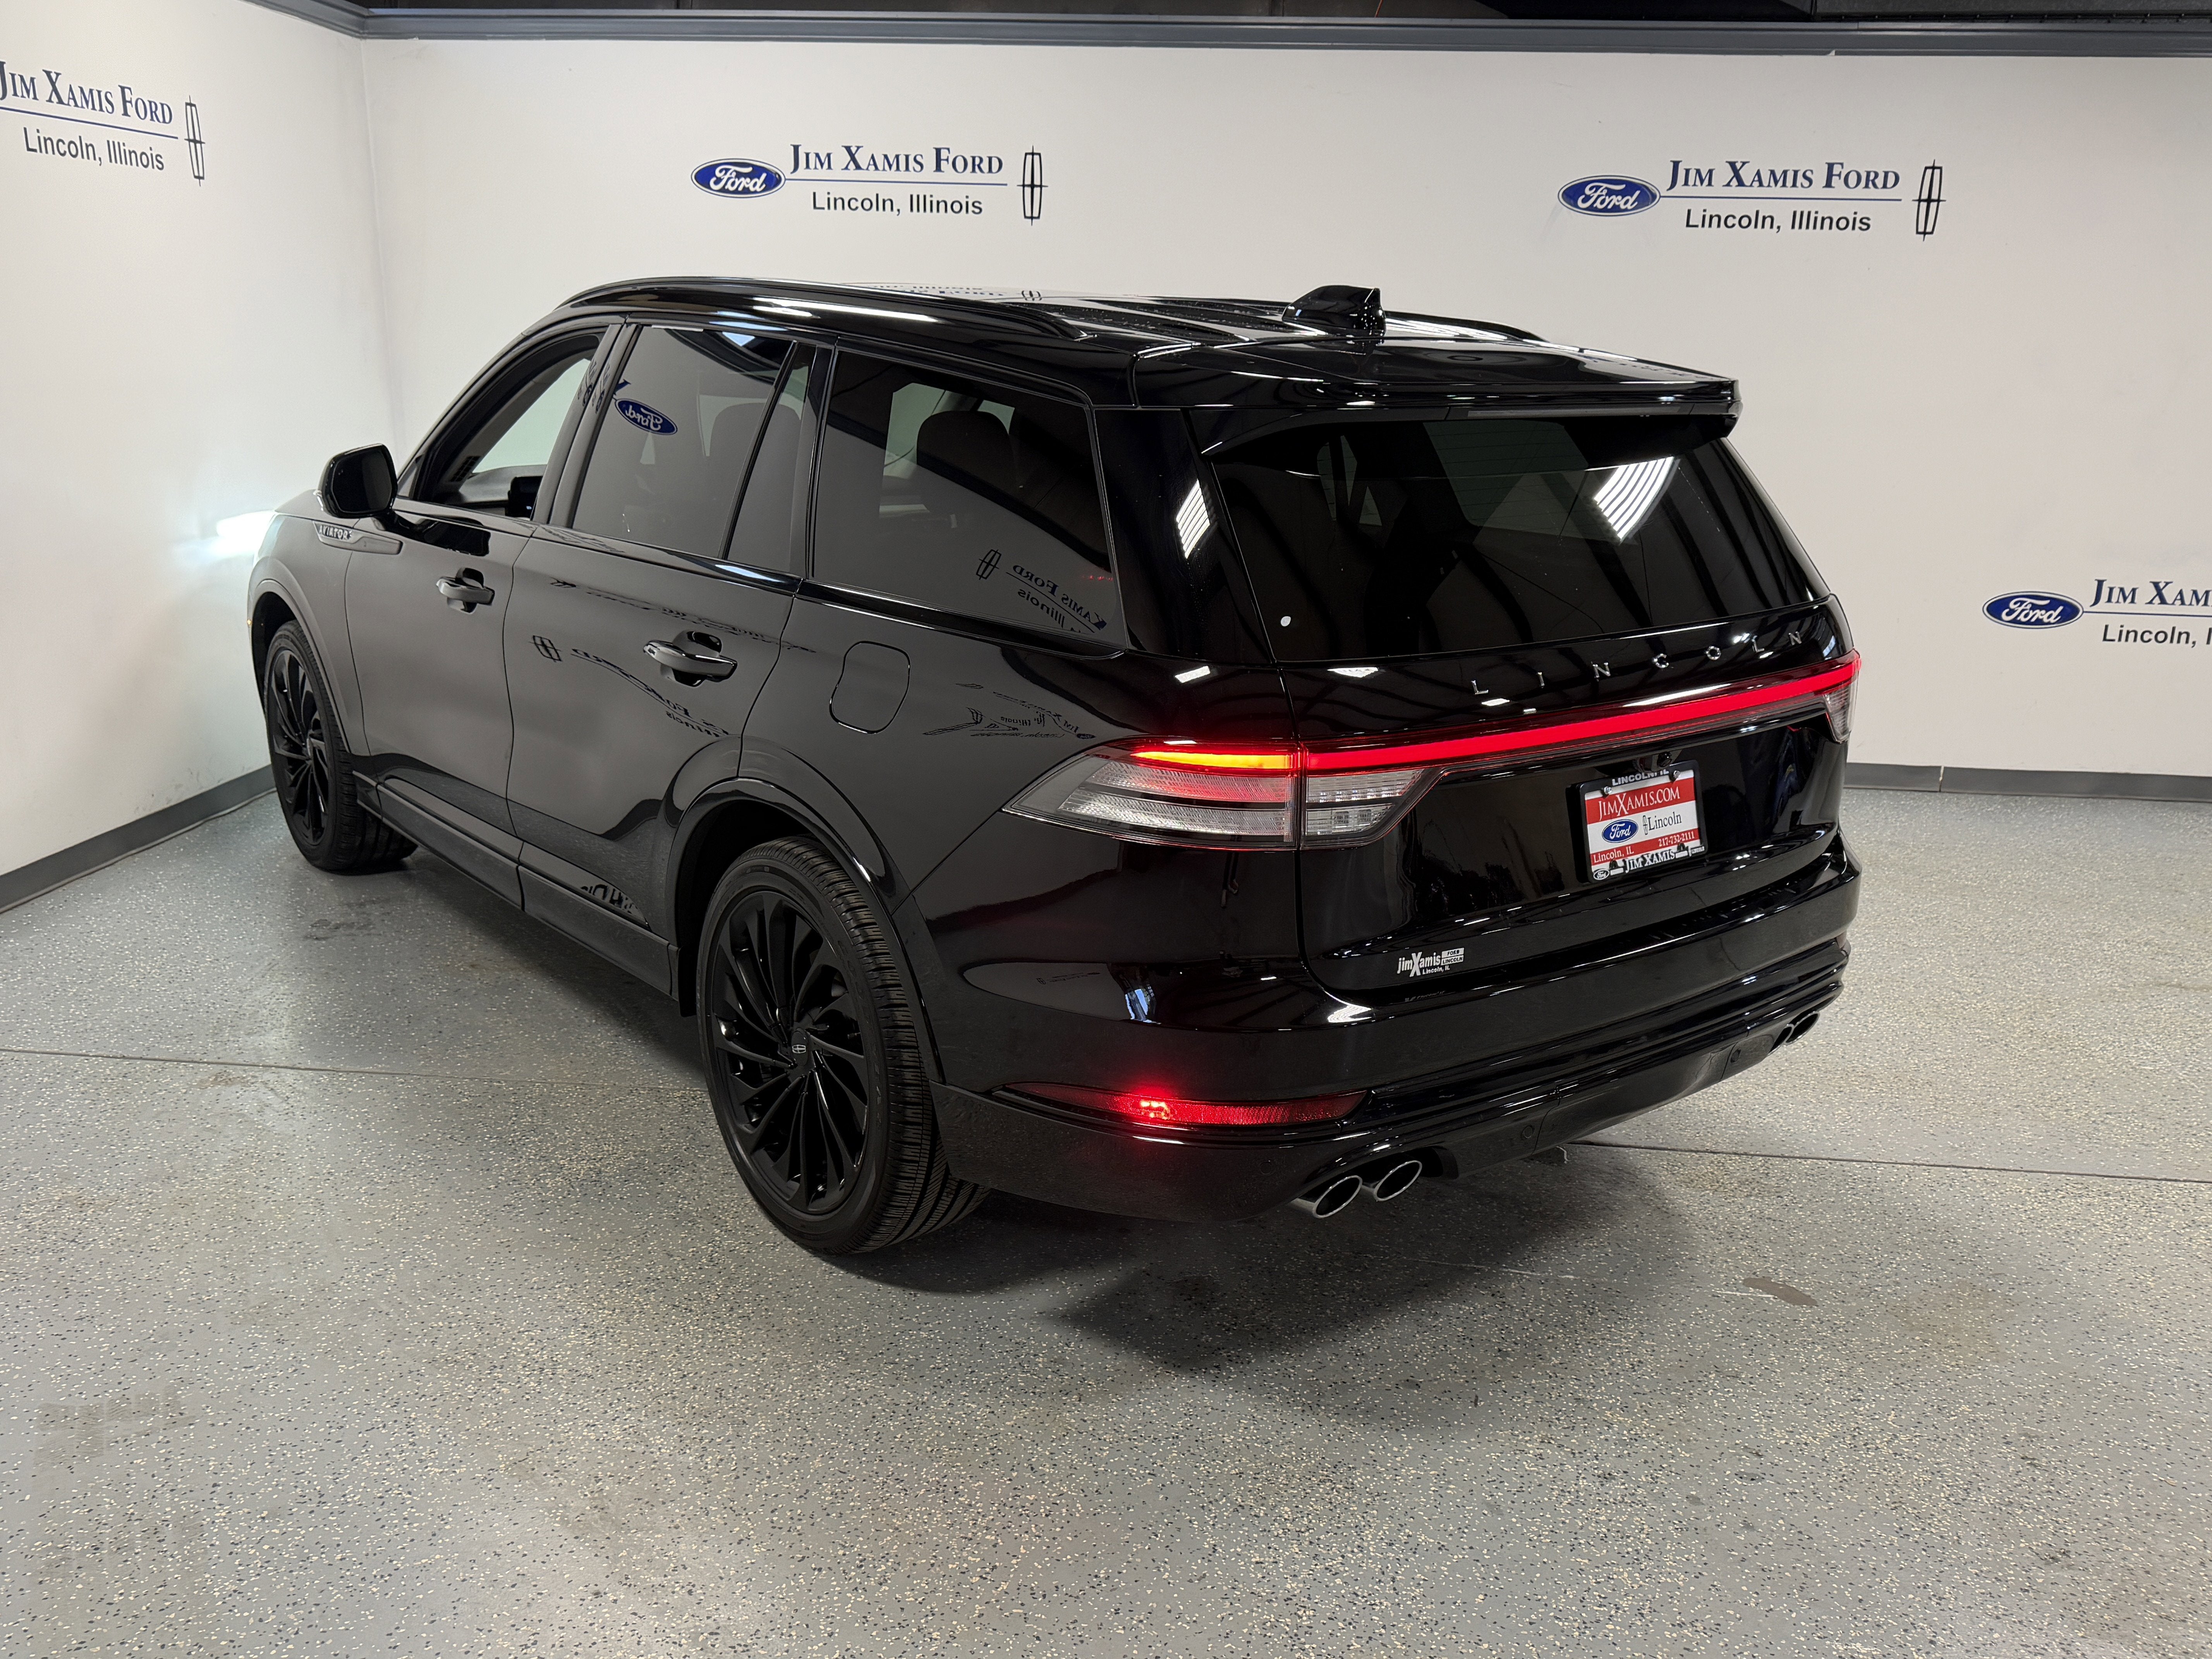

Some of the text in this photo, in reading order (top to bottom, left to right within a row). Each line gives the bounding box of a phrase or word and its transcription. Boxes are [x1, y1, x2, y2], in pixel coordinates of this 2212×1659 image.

[0, 61, 172, 124] JIM XAMIS FORD
[23, 127, 164, 170] Lincoln, Illinois
[790, 144, 1003, 174] JIM XAMIS FORD
[1666, 160, 1900, 191] JIM XAMIS FORD
[813, 192, 983, 216] Lincoln, Illinois
[1685, 209, 1871, 234] Lincoln, Illinois
[320, 525, 348, 539] AVIATOR
[2089, 579, 2212, 607] JIM XAM
[2102, 624, 2197, 648] Lincoln,
[1470, 630, 1802, 695] LINCOLN
[1598, 786, 1680, 821] JIMXAMIS.COM
[1648, 811, 1682, 831] Lincoln
[1658, 831, 1695, 847] 217-732-2111
[1593, 846, 1634, 863] Lincoln, IL
[1625, 859, 1643, 873] JIM
[1644, 850, 1676, 867] XAMIS
